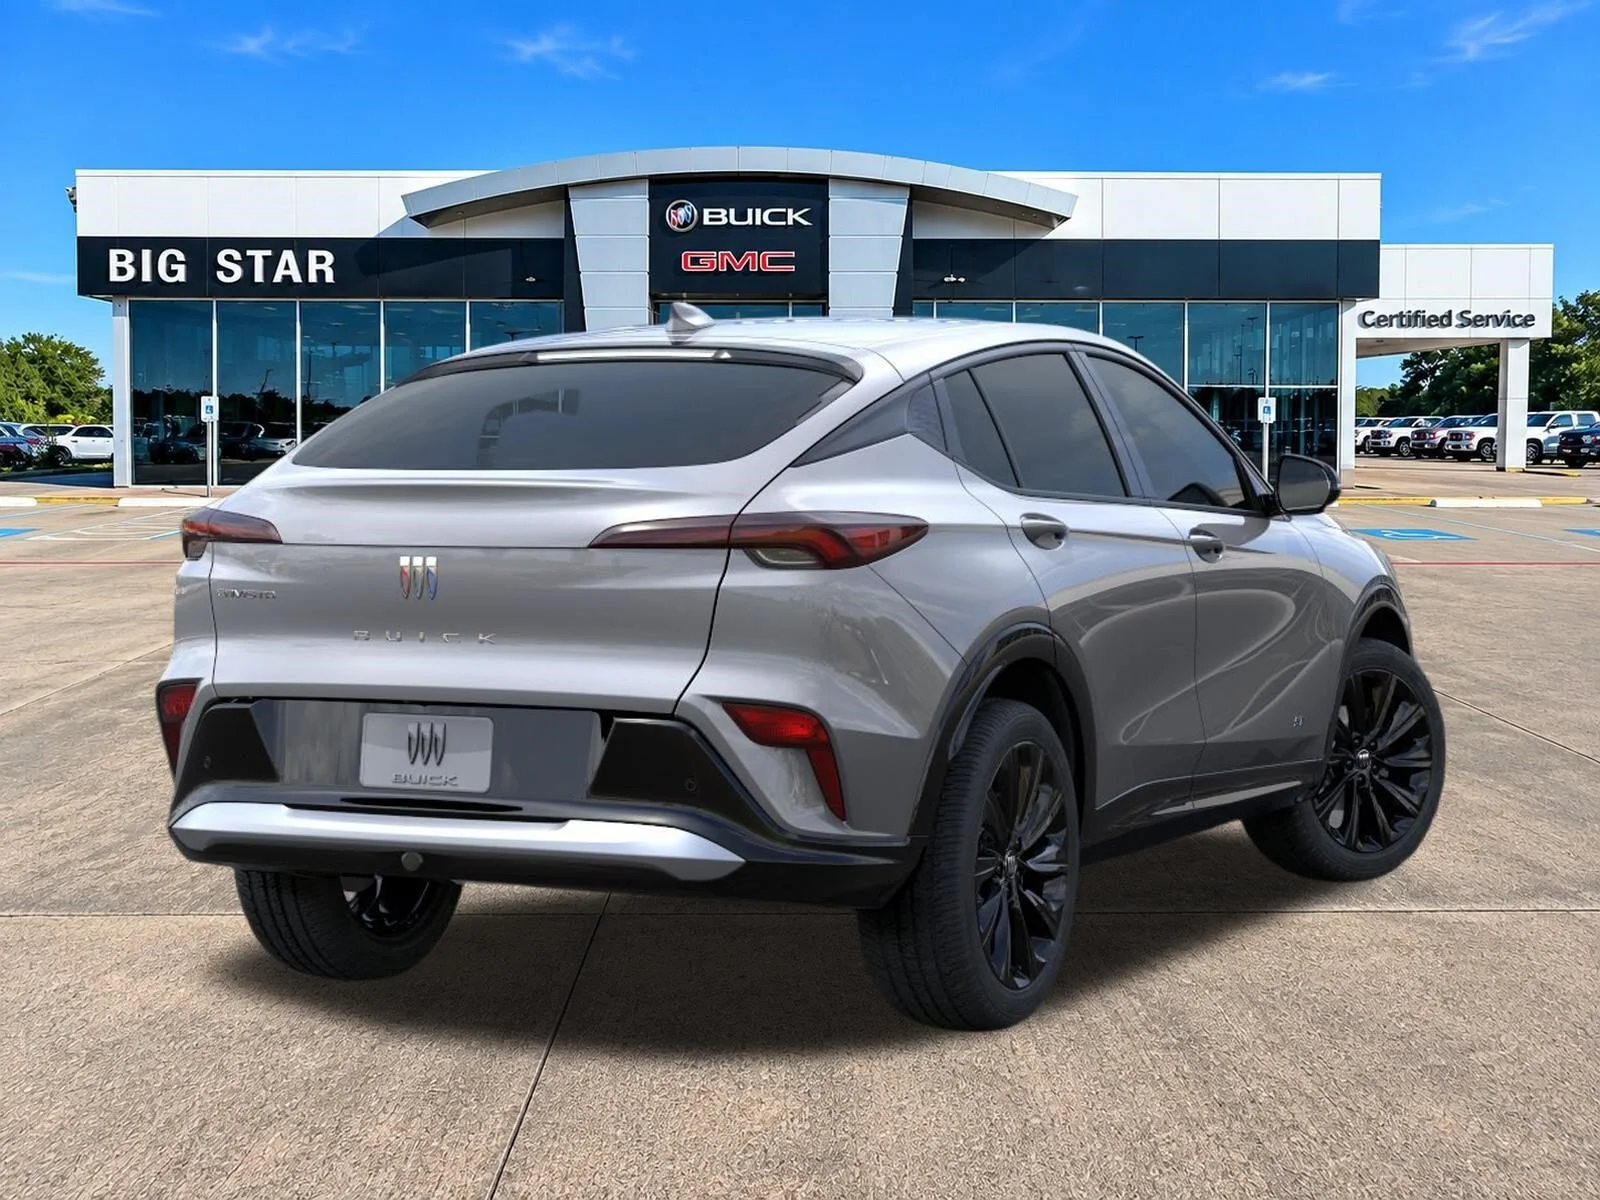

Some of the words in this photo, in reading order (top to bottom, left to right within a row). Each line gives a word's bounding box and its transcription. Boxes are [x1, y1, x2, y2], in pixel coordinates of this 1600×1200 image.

[702, 208, 812, 226] BUICK
[108, 248, 187, 283] BIG
[216, 249, 336, 284] STAR
[681, 251, 795, 272] GMC
[1360, 309, 1453, 328] Certified
[1456, 309, 1536, 328] Service
[353, 630, 496, 643] BUICK
[392, 773, 458, 787] BUICK
